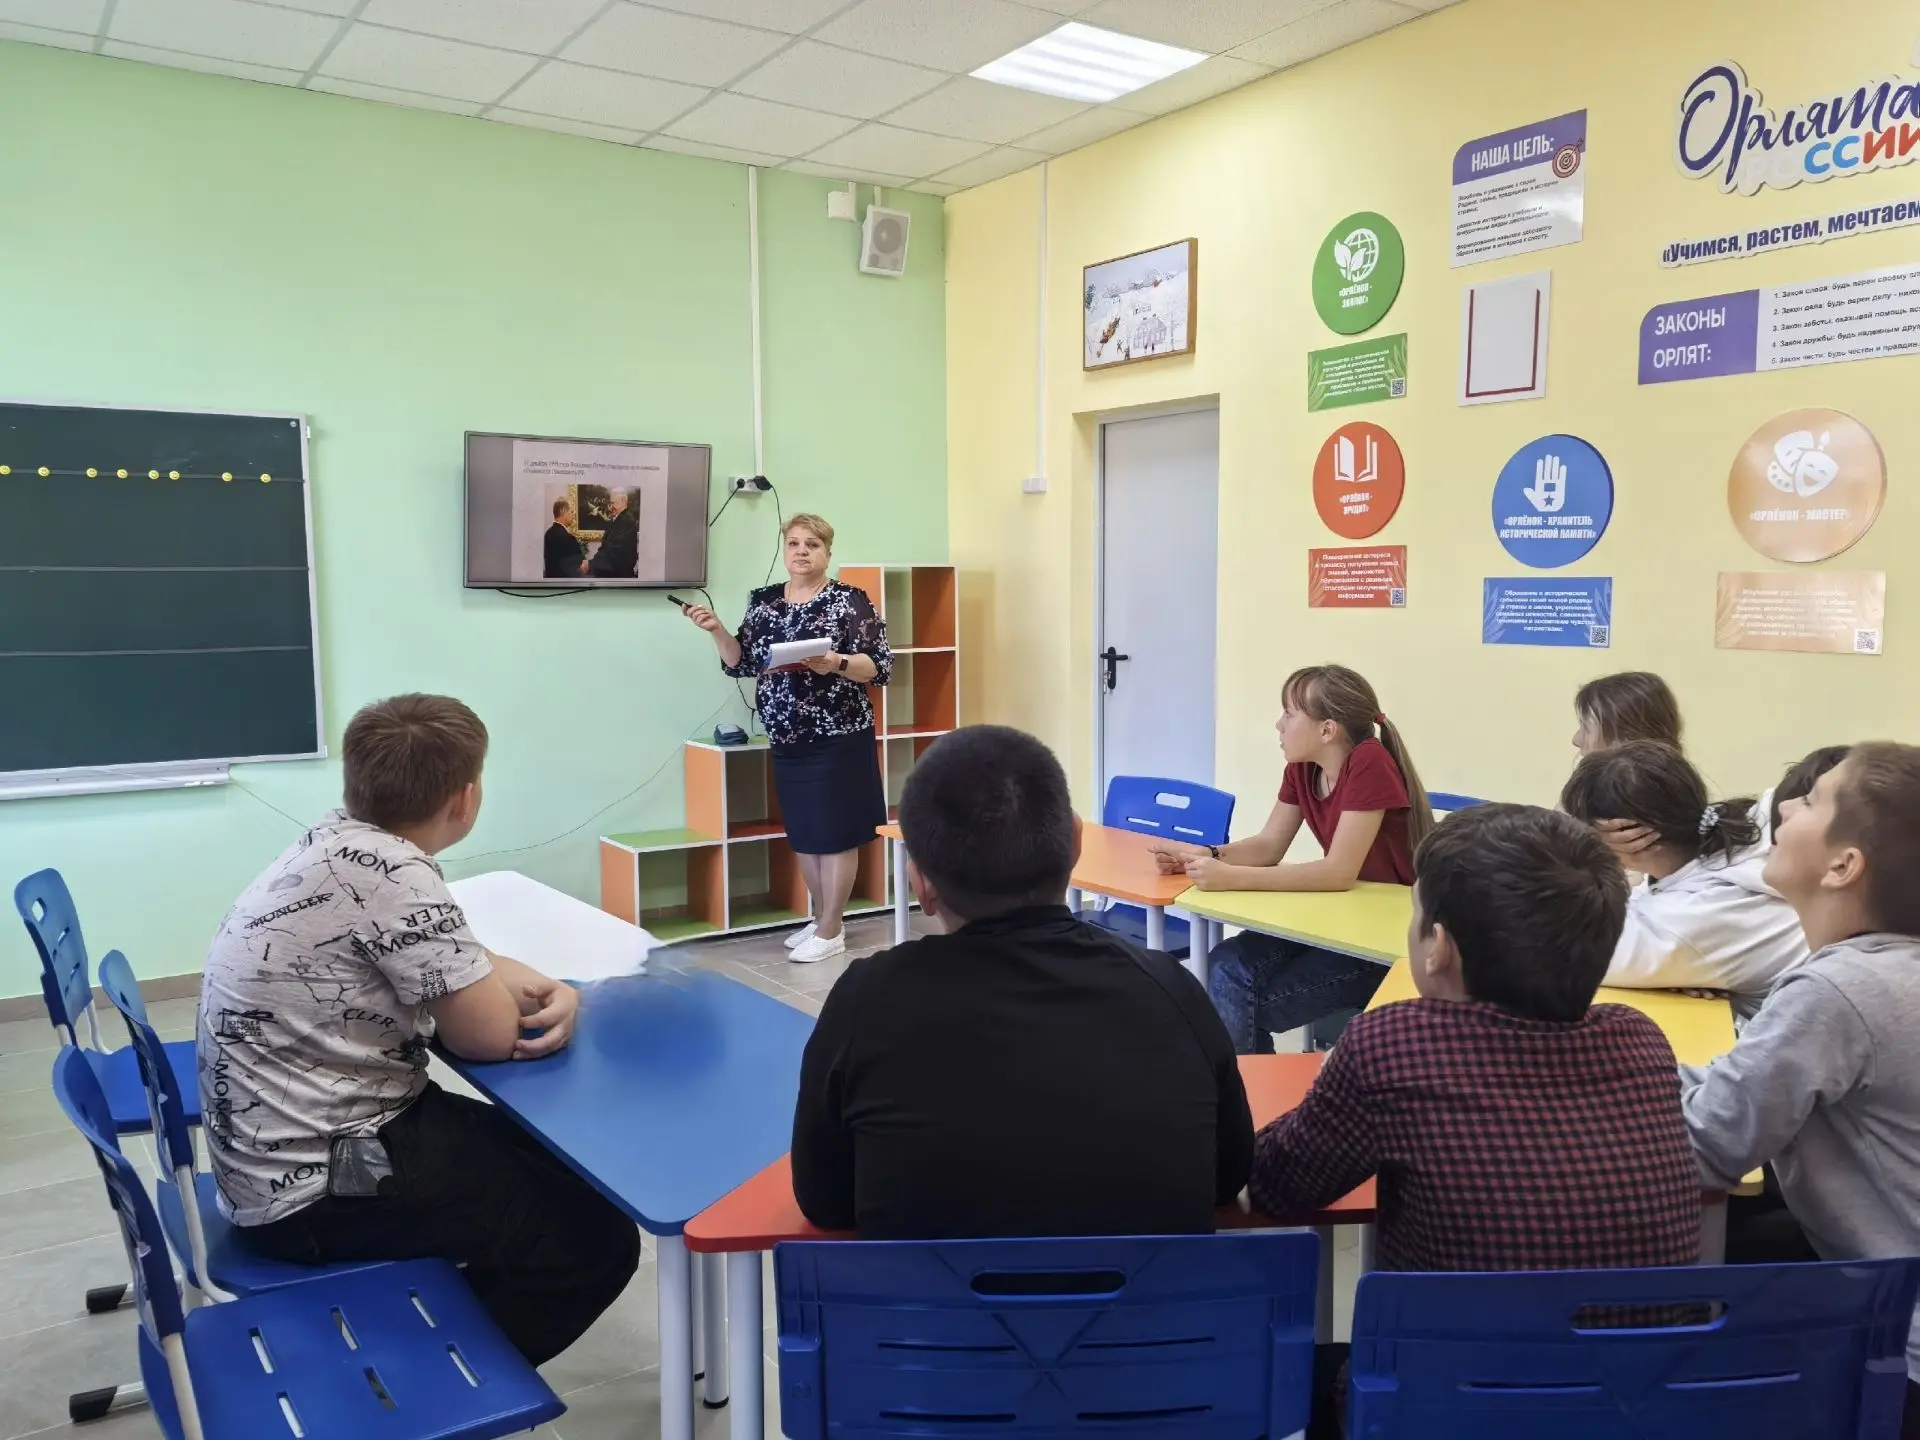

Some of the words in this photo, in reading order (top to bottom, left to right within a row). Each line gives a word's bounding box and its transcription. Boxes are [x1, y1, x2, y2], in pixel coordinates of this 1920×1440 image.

[1471, 144, 1510, 172] НАША
[1514, 135, 1554, 162] ЦЕЛЬ:
[1662, 238, 1742, 263] «Учимся,
[1747, 220, 1823, 252] растем,
[1654, 306, 1726, 335] ЗАКОНЫ
[1653, 343, 1711, 369] ОРЛЯТ:
[1500, 528, 1559, 539] ИСТОРИЧЕСКОЙ
[1547, 515, 1593, 526] ХРАНИТЕЛЬ
[342, 1007, 397, 1026] CLER
